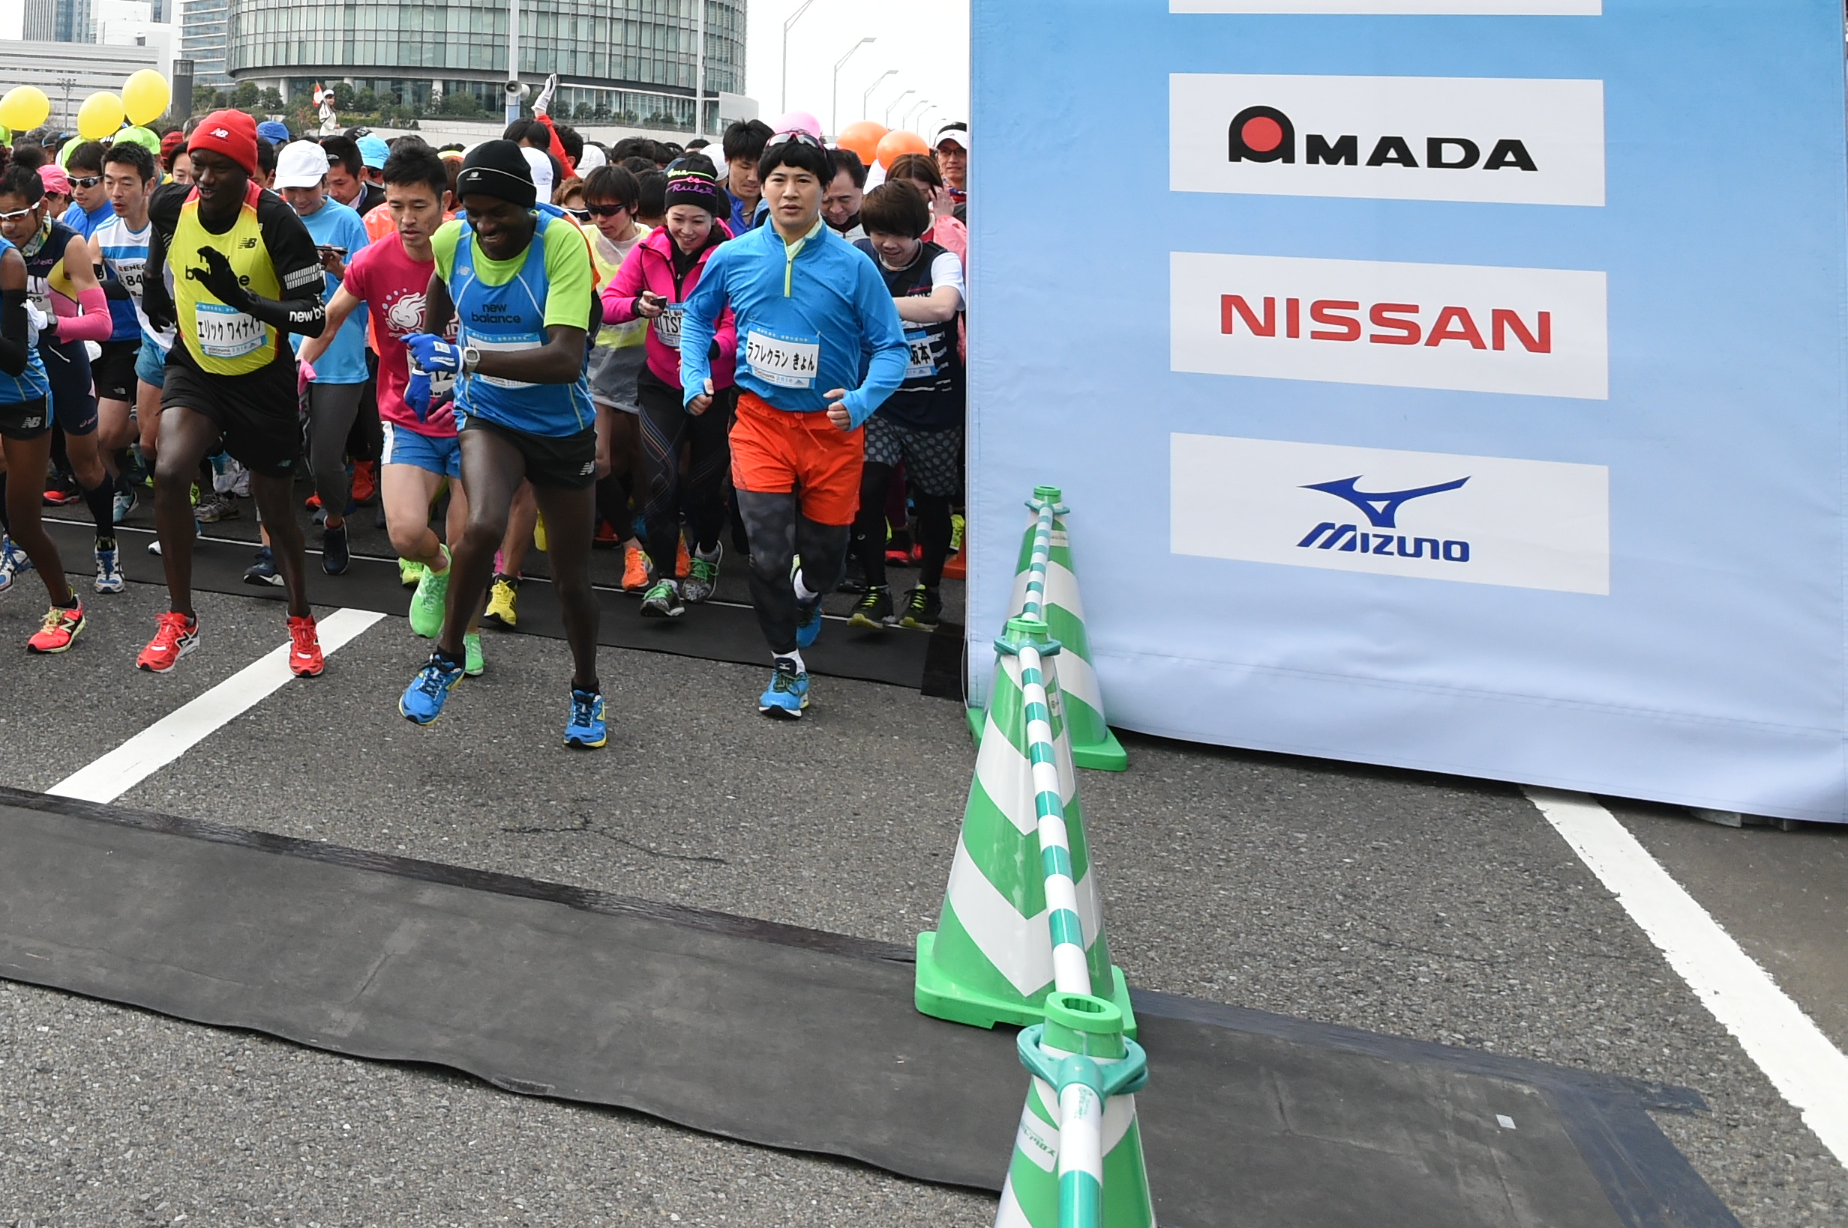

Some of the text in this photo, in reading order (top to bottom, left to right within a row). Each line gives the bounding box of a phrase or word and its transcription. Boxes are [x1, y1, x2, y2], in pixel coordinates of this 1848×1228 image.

[1228, 104, 1539, 172] AMADA
[289, 310, 314, 323] new
[471, 313, 522, 325] balance
[482, 303, 507, 313] new
[197, 319, 224, 342] エリック
[1220, 293, 1552, 354] NISSAN
[748, 341, 815, 372] ラフレクラン きょん
[1295, 521, 1471, 563] MIZUNO
